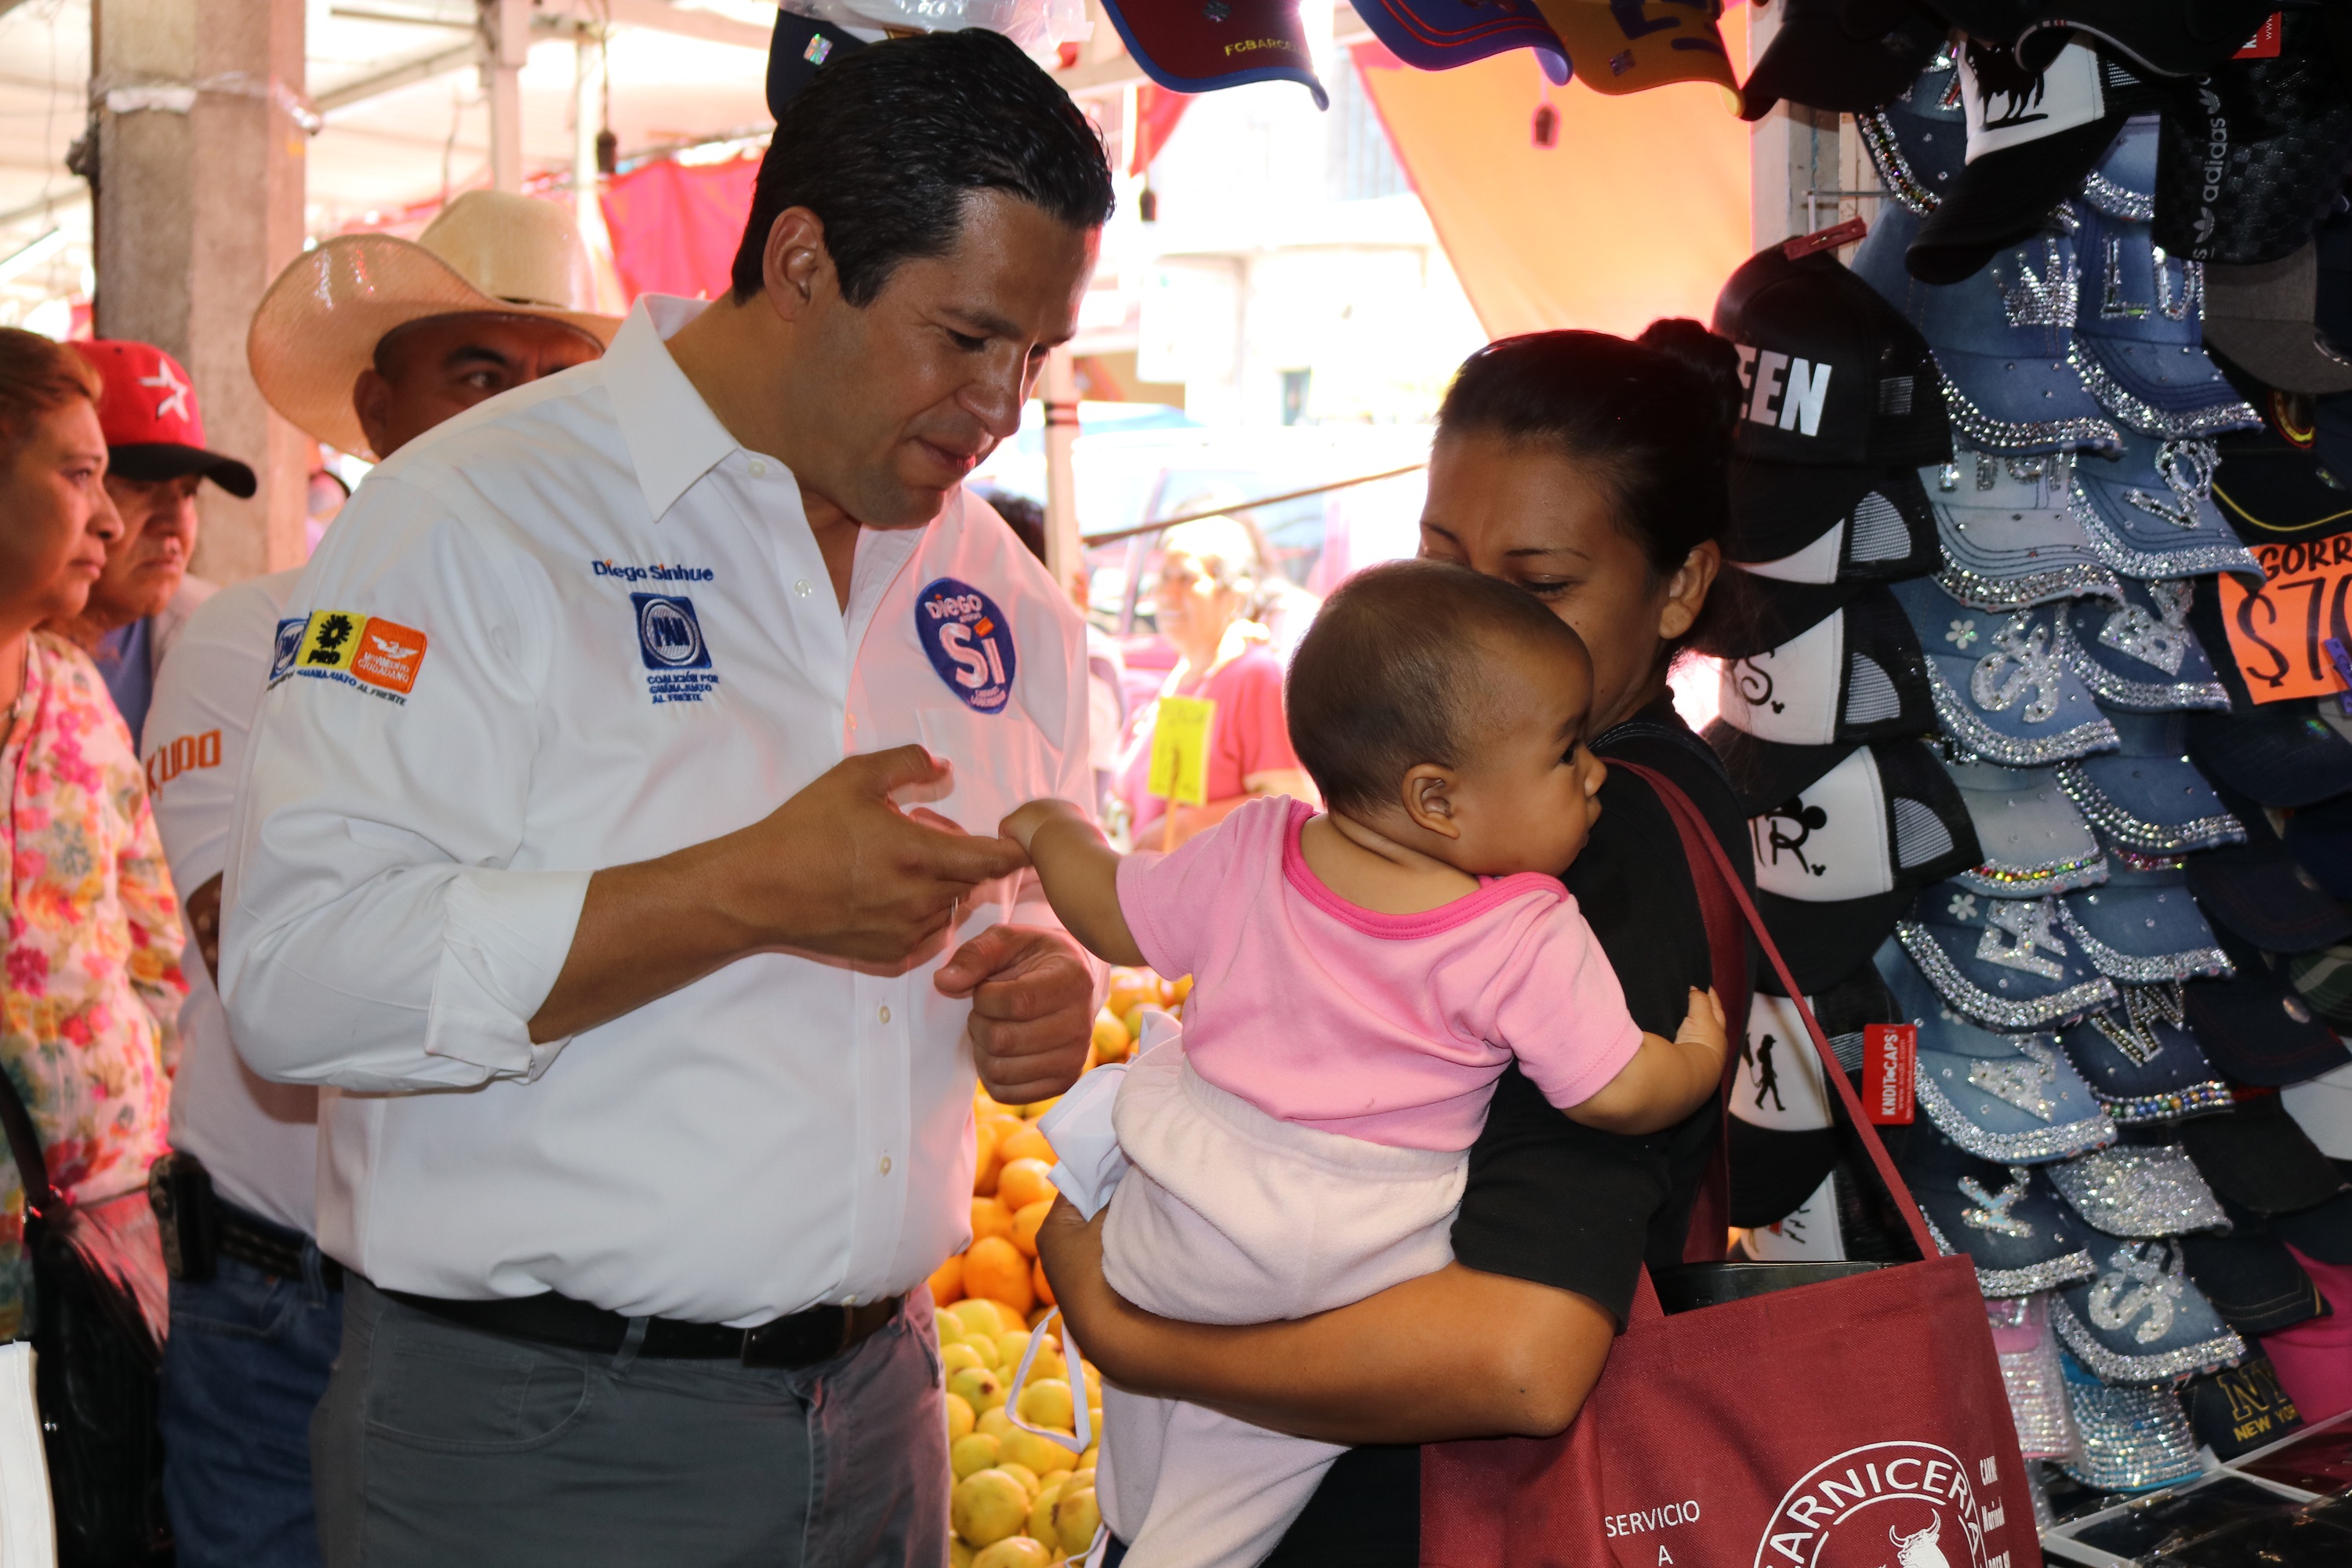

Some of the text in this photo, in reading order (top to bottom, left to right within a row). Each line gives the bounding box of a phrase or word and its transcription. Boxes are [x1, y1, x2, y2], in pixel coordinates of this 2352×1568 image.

[2202, 118, 2227, 202] adidas
[592, 559, 714, 582] Diego Sinhue
[358, 658, 409, 683] CIUDADANO
[2233, 1415, 2272, 1442] NEW
[1605, 1500, 1700, 1537] SERVICIO
[1767, 1458, 1980, 1568] ARNICERIA
[1658, 1544, 1674, 1567] A
